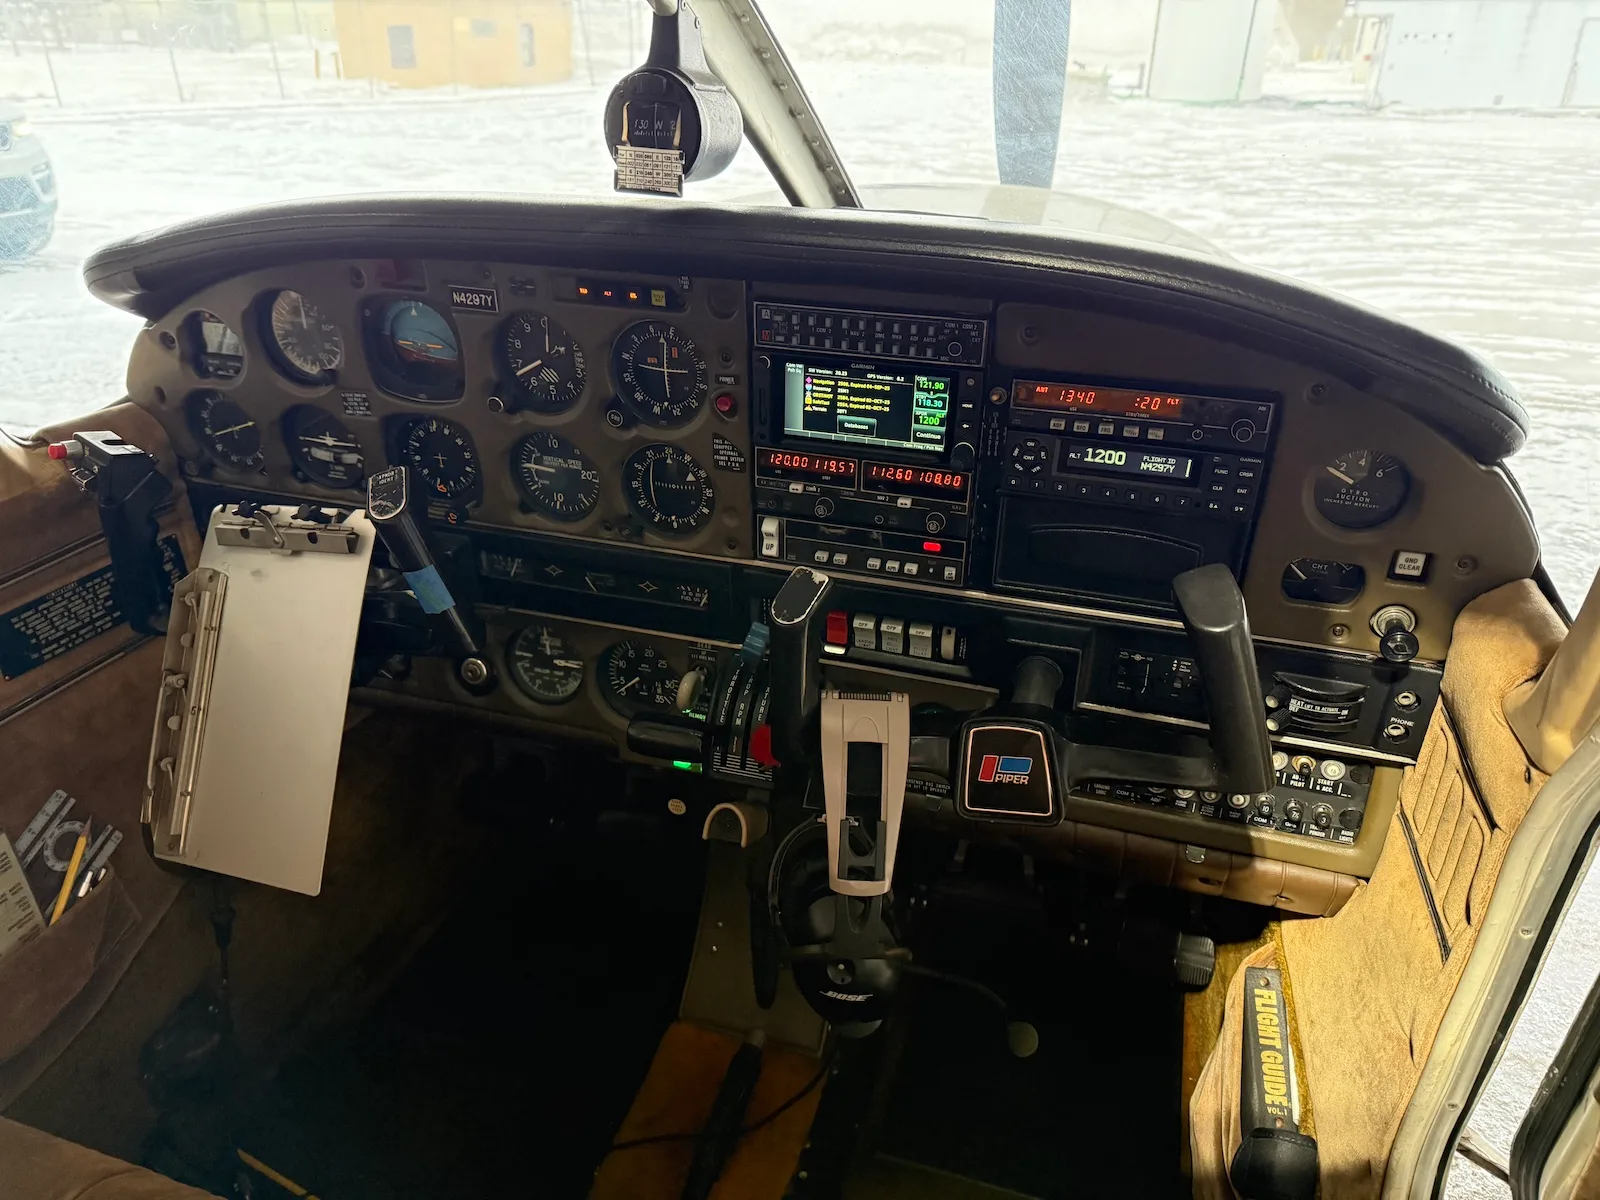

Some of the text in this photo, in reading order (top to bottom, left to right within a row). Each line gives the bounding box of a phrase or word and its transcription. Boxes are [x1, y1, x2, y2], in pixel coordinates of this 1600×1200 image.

[452, 292, 492, 306] N4297Y
[523, 323, 531, 333] 9
[514, 340, 522, 349] 8
[516, 359, 522, 368] 7
[530, 376, 538, 386] 6
[920, 381, 945, 390] 121.90
[549, 384, 557, 395] 5
[1060, 390, 1096, 404] 1340
[918, 399, 942, 408] 118.30
[919, 416, 940, 425] 1200
[916, 432, 941, 440] Continue
[548, 439, 559, 449] 10
[770, 453, 809, 468] 120.00
[1084, 448, 1126, 465] 1200
[1340, 462, 1347, 472] 2
[1358, 458, 1366, 466] 4
[1140, 462, 1175, 473] N4297Y
[581, 470, 593, 480] 20
[872, 466, 962, 487] 112.60 108.80
[1376, 469, 1383, 478] 6
[554, 492, 564, 502] 10
[1336, 493, 1371, 502] SUCTION
[1399, 563, 1420, 571] CLEAR
[628, 650, 635, 658] 15
[644, 649, 654, 657] 20
[658, 660, 668, 668] 25
[665, 680, 674, 689] 30
[655, 695, 665, 703] 35
[720, 670, 740, 723] THROTTLE
[736, 703, 745, 726] RPM
[1390, 716, 1414, 727] PHONE
[995, 774, 1029, 785] PIPER
[1254, 988, 1282, 1051] FLIGHT
[1260, 1050, 1289, 1107] GUIDE
